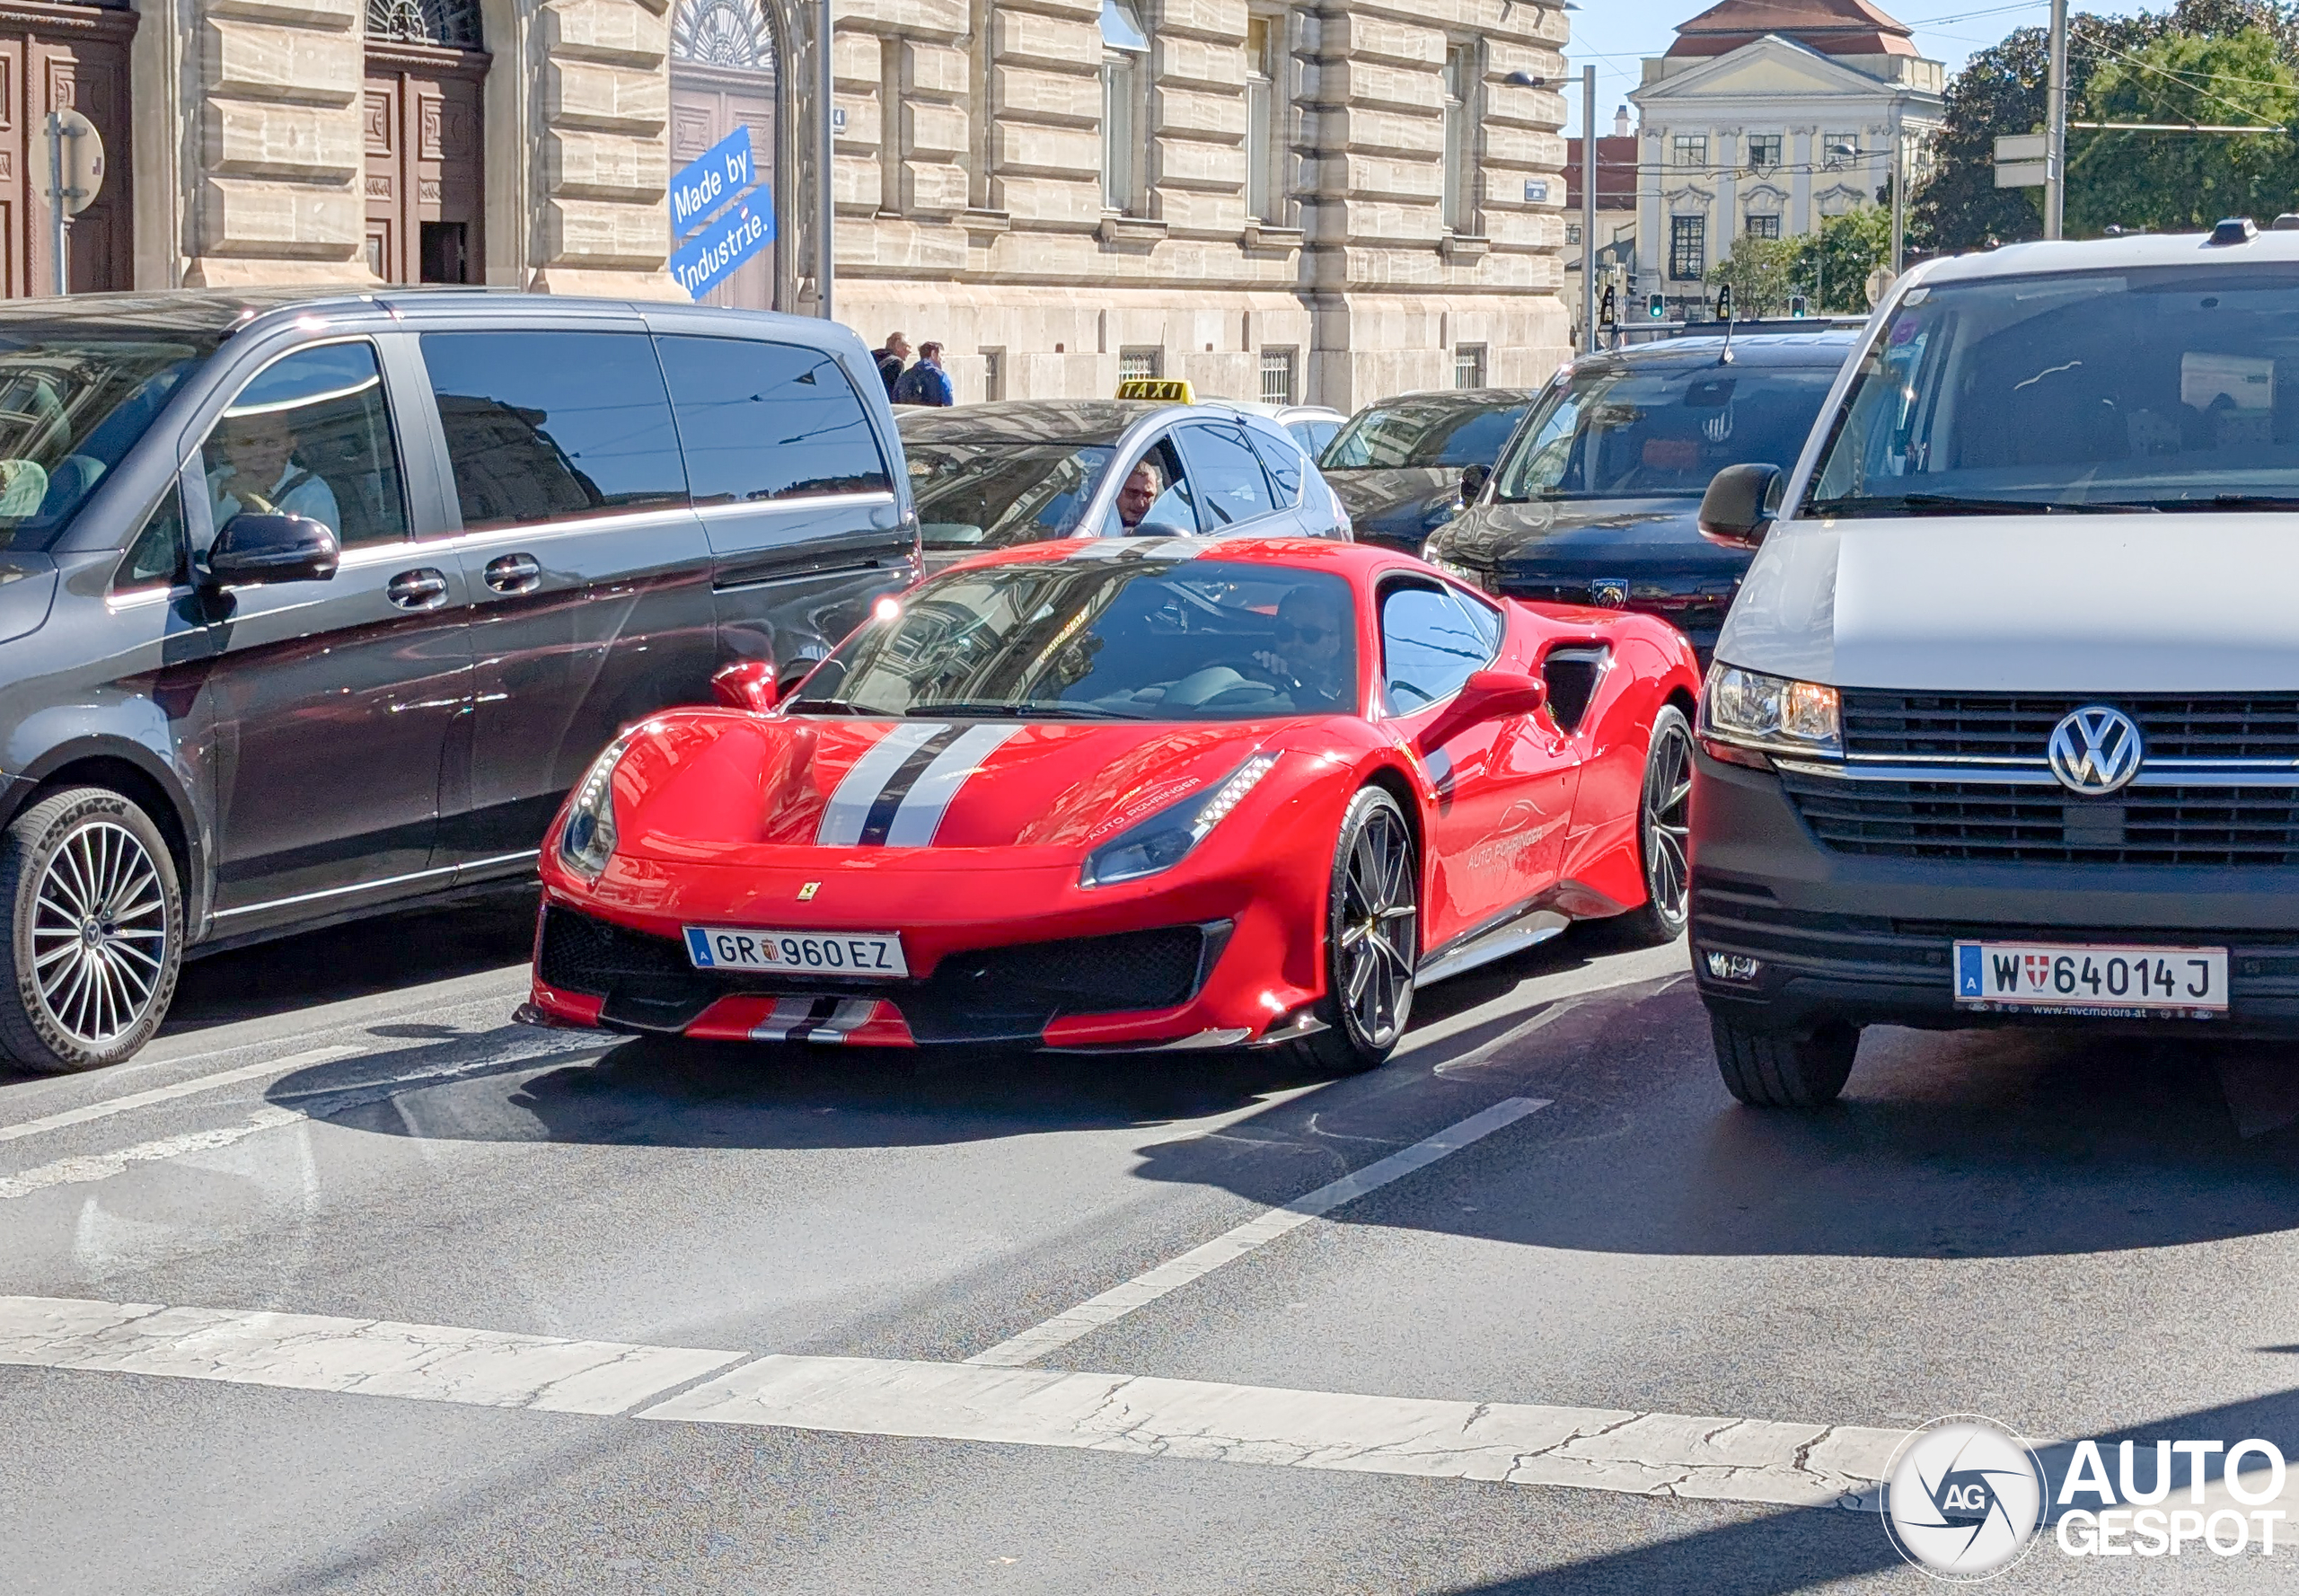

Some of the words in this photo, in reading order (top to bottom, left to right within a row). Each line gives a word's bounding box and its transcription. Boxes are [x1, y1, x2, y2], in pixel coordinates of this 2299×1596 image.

[674, 169, 723, 225] Made
[725, 149, 747, 184] by
[677, 214, 769, 291] Industrie.
[1123, 382, 1178, 399] TAXI
[2053, 709, 2137, 790] VW
[1088, 816, 1125, 841] AUTO
[1467, 847, 1493, 871] AUTO
[700, 951, 709, 961] A
[716, 935, 760, 964] GR
[780, 938, 844, 967] 960
[848, 940, 893, 968] EZ
[1965, 976, 1977, 989] A
[1992, 954, 2020, 992] W
[2054, 956, 2175, 997] 64014
[2186, 959, 2209, 998] J
[2032, 1005, 2146, 1018] www.mvcmotors.at
